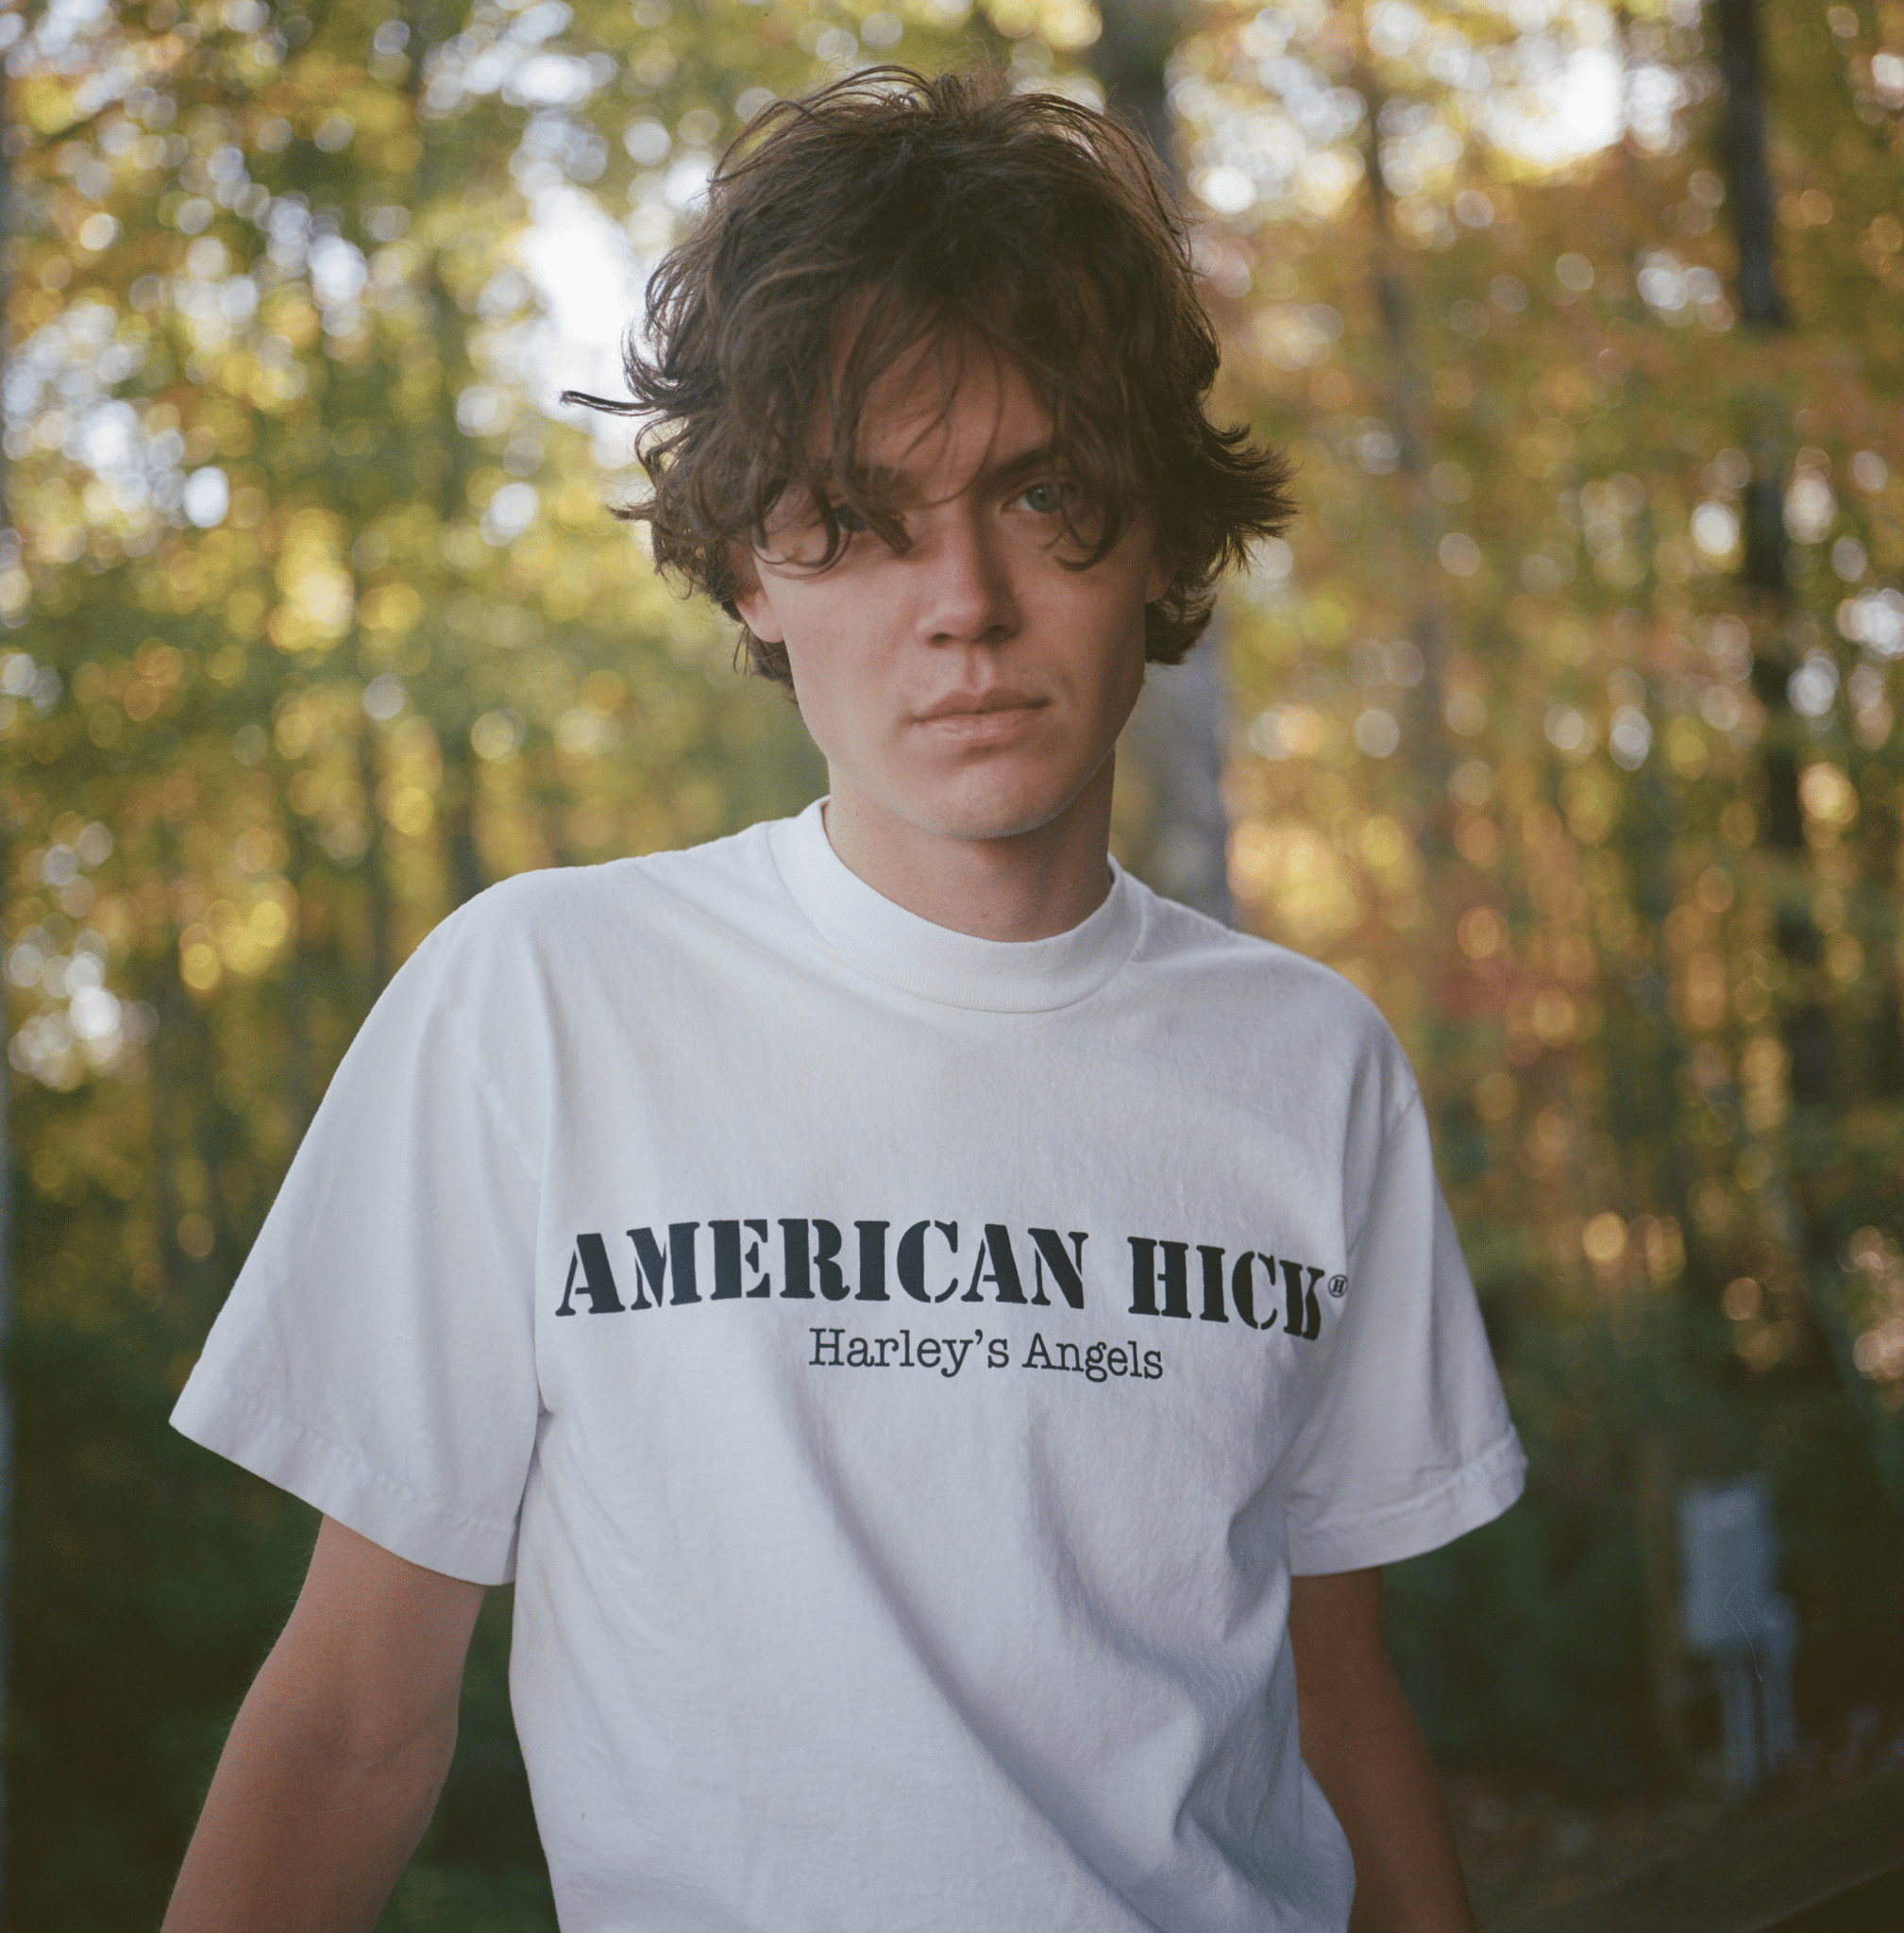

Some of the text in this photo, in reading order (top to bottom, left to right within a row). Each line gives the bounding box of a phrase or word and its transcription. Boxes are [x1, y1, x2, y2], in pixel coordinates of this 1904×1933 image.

[555, 1219, 1089, 1318] AMERICAN
[1127, 1235, 1325, 1341] HICK
[808, 1327, 1164, 1384] Harley’s Angels
